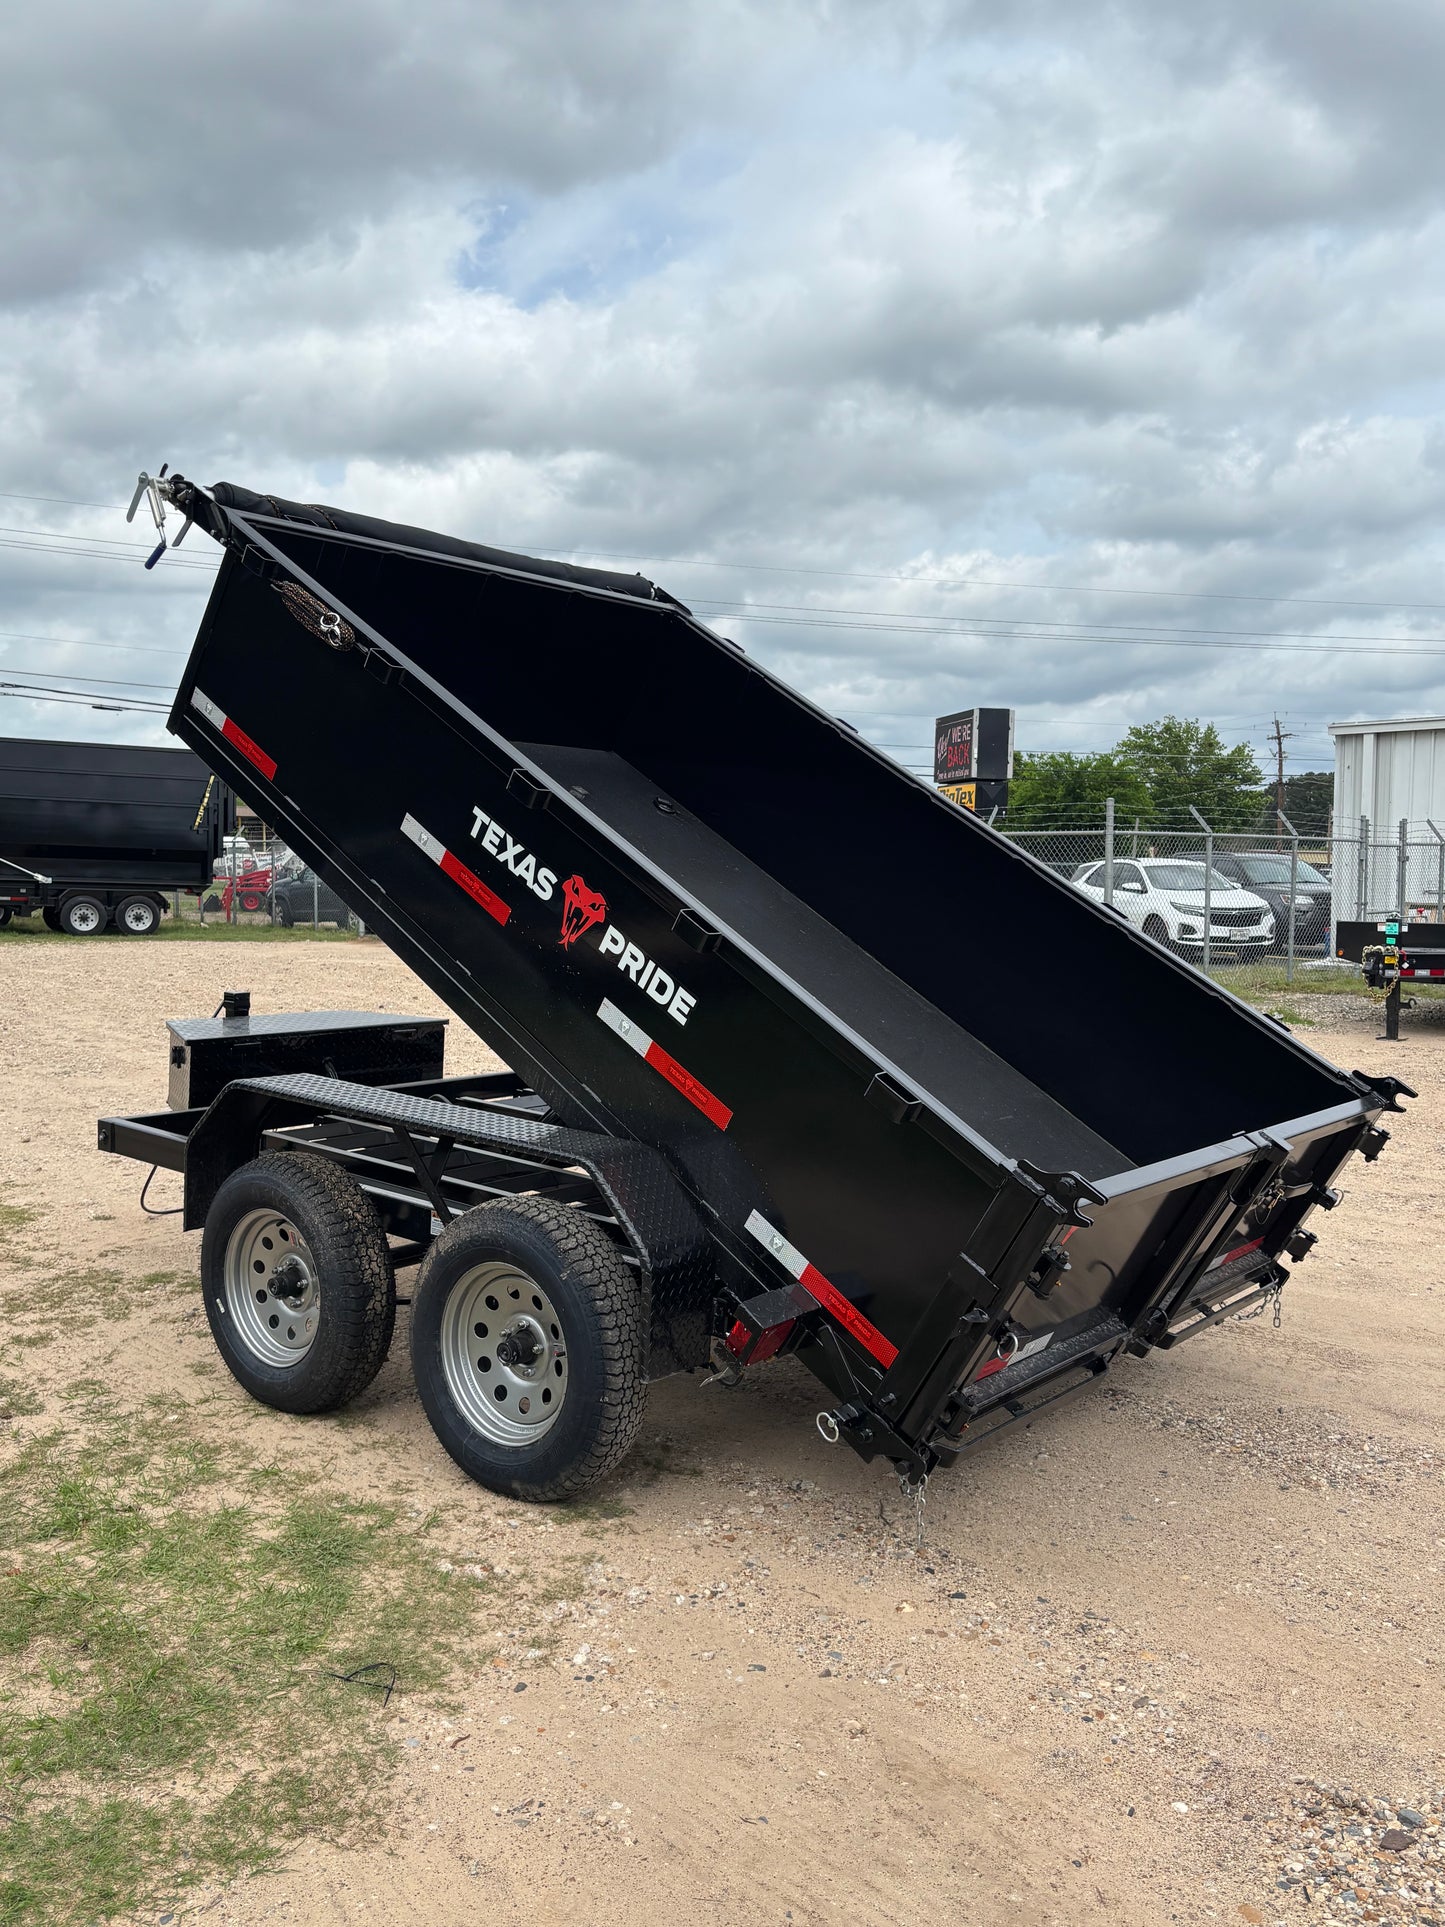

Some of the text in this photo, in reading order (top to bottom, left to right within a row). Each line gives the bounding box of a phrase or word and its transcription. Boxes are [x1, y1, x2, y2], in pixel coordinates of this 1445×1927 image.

[947, 743, 970, 768] BACK
[469, 805, 697, 1026] TEXAS PRIDE
[828, 1294, 846, 1314] TEXAS
